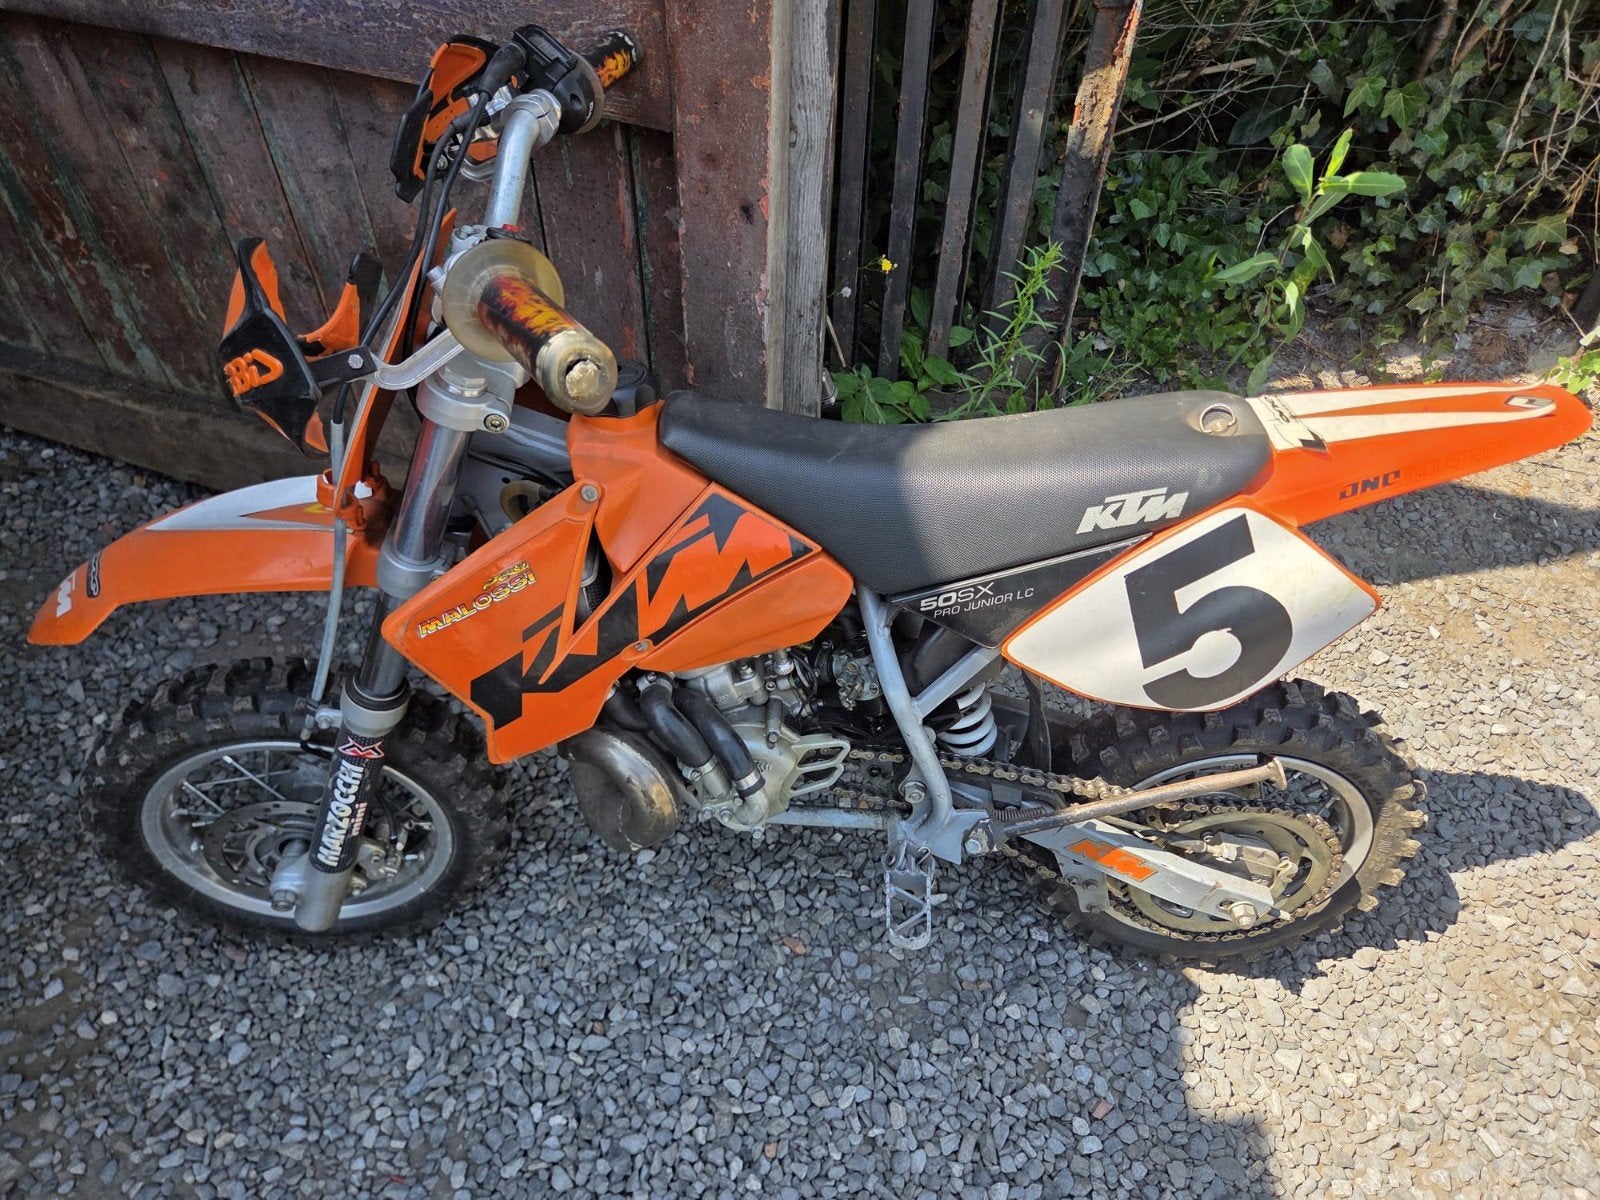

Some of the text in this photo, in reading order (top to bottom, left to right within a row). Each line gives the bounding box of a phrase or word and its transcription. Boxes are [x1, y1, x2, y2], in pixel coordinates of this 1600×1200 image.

[1076, 487, 1189, 535] KTM
[418, 569, 537, 639] MALOSSI
[920, 582, 995, 612] 50SX
[933, 588, 1034, 619] PRO JUNIOR LC
[1124, 513, 1293, 709] 5
[316, 759, 364, 867] MARZOCCHI
[350, 802, 368, 837] mini
